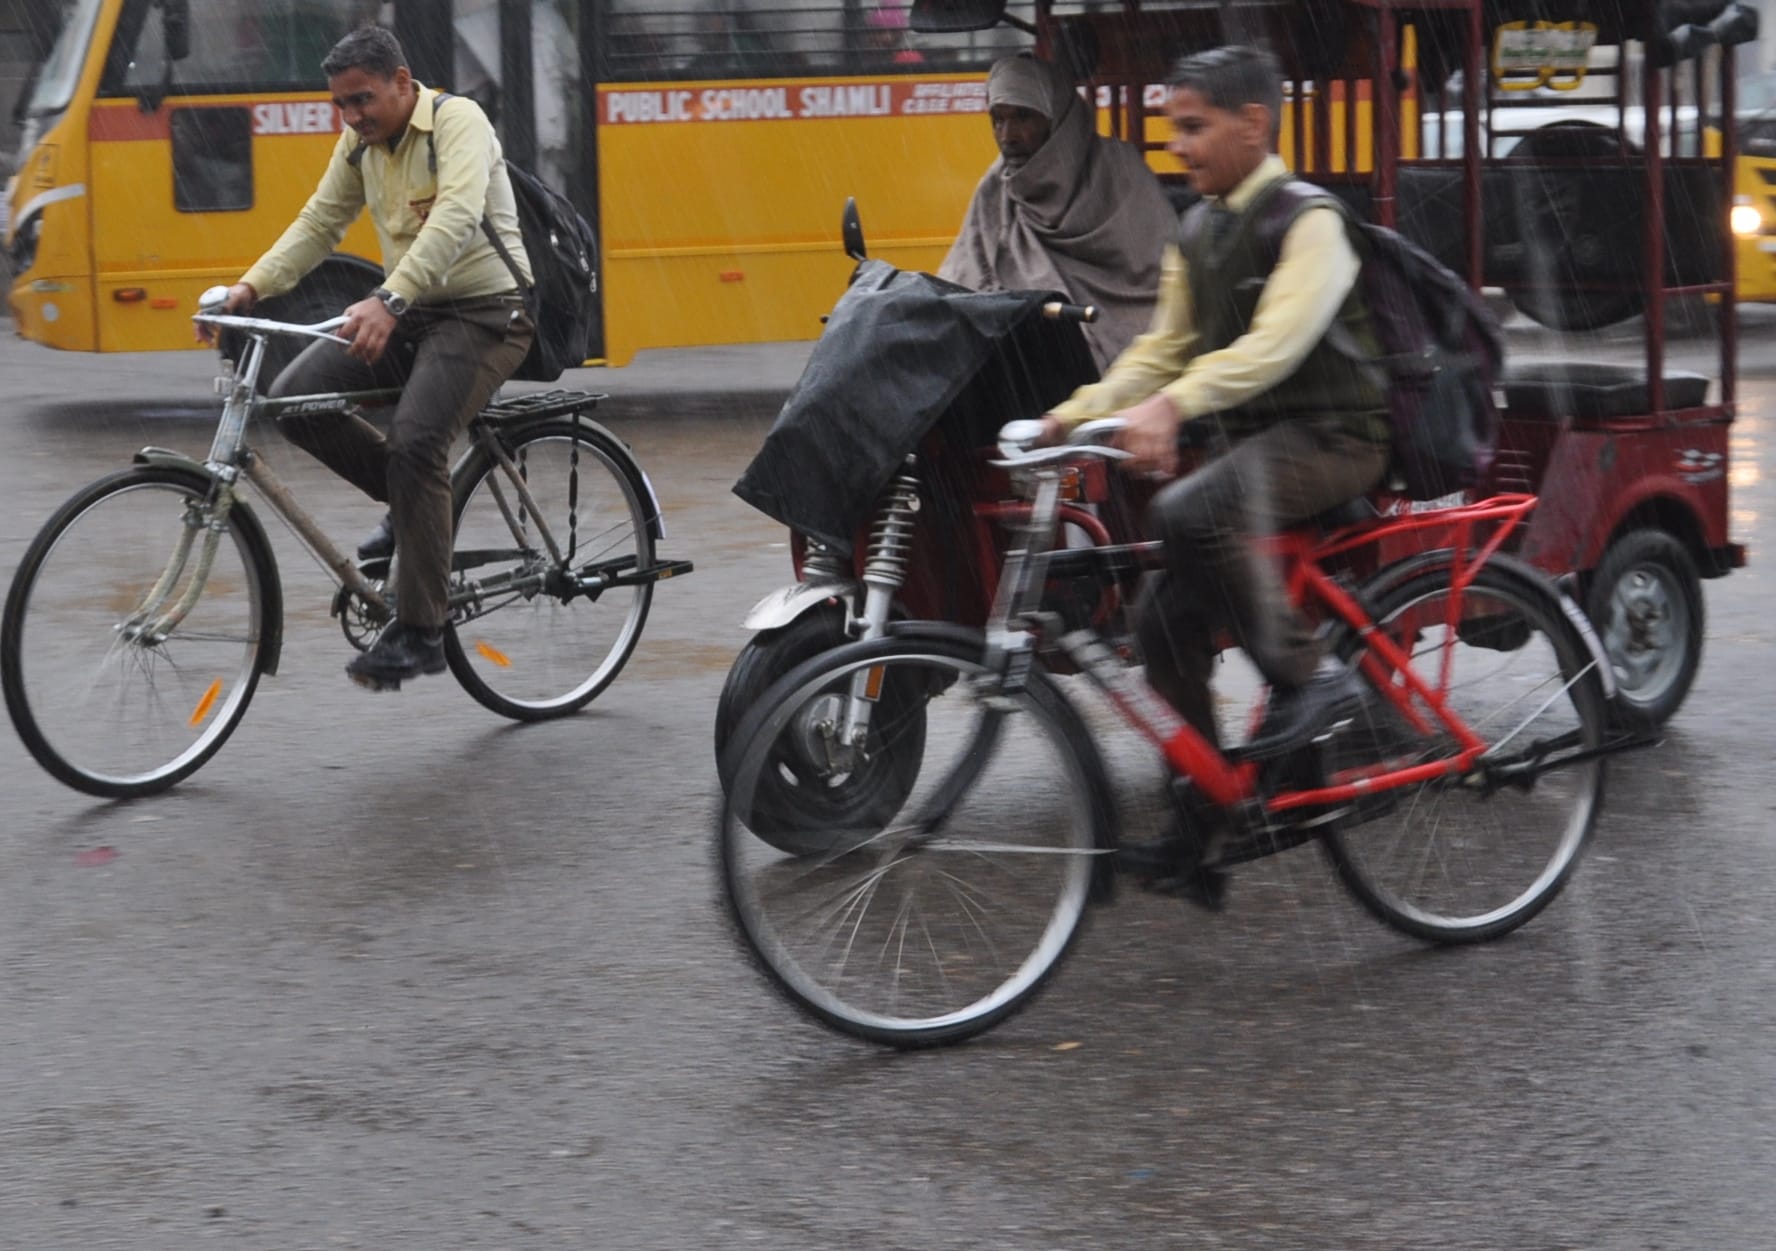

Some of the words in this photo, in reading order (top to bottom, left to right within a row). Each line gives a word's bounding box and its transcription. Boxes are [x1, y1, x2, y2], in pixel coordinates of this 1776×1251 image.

[254, 102, 333, 134] SILVER
[607, 91, 692, 122] PUBLIC
[701, 88, 792, 120] SCHOOL
[800, 85, 891, 117] SHAMLI
